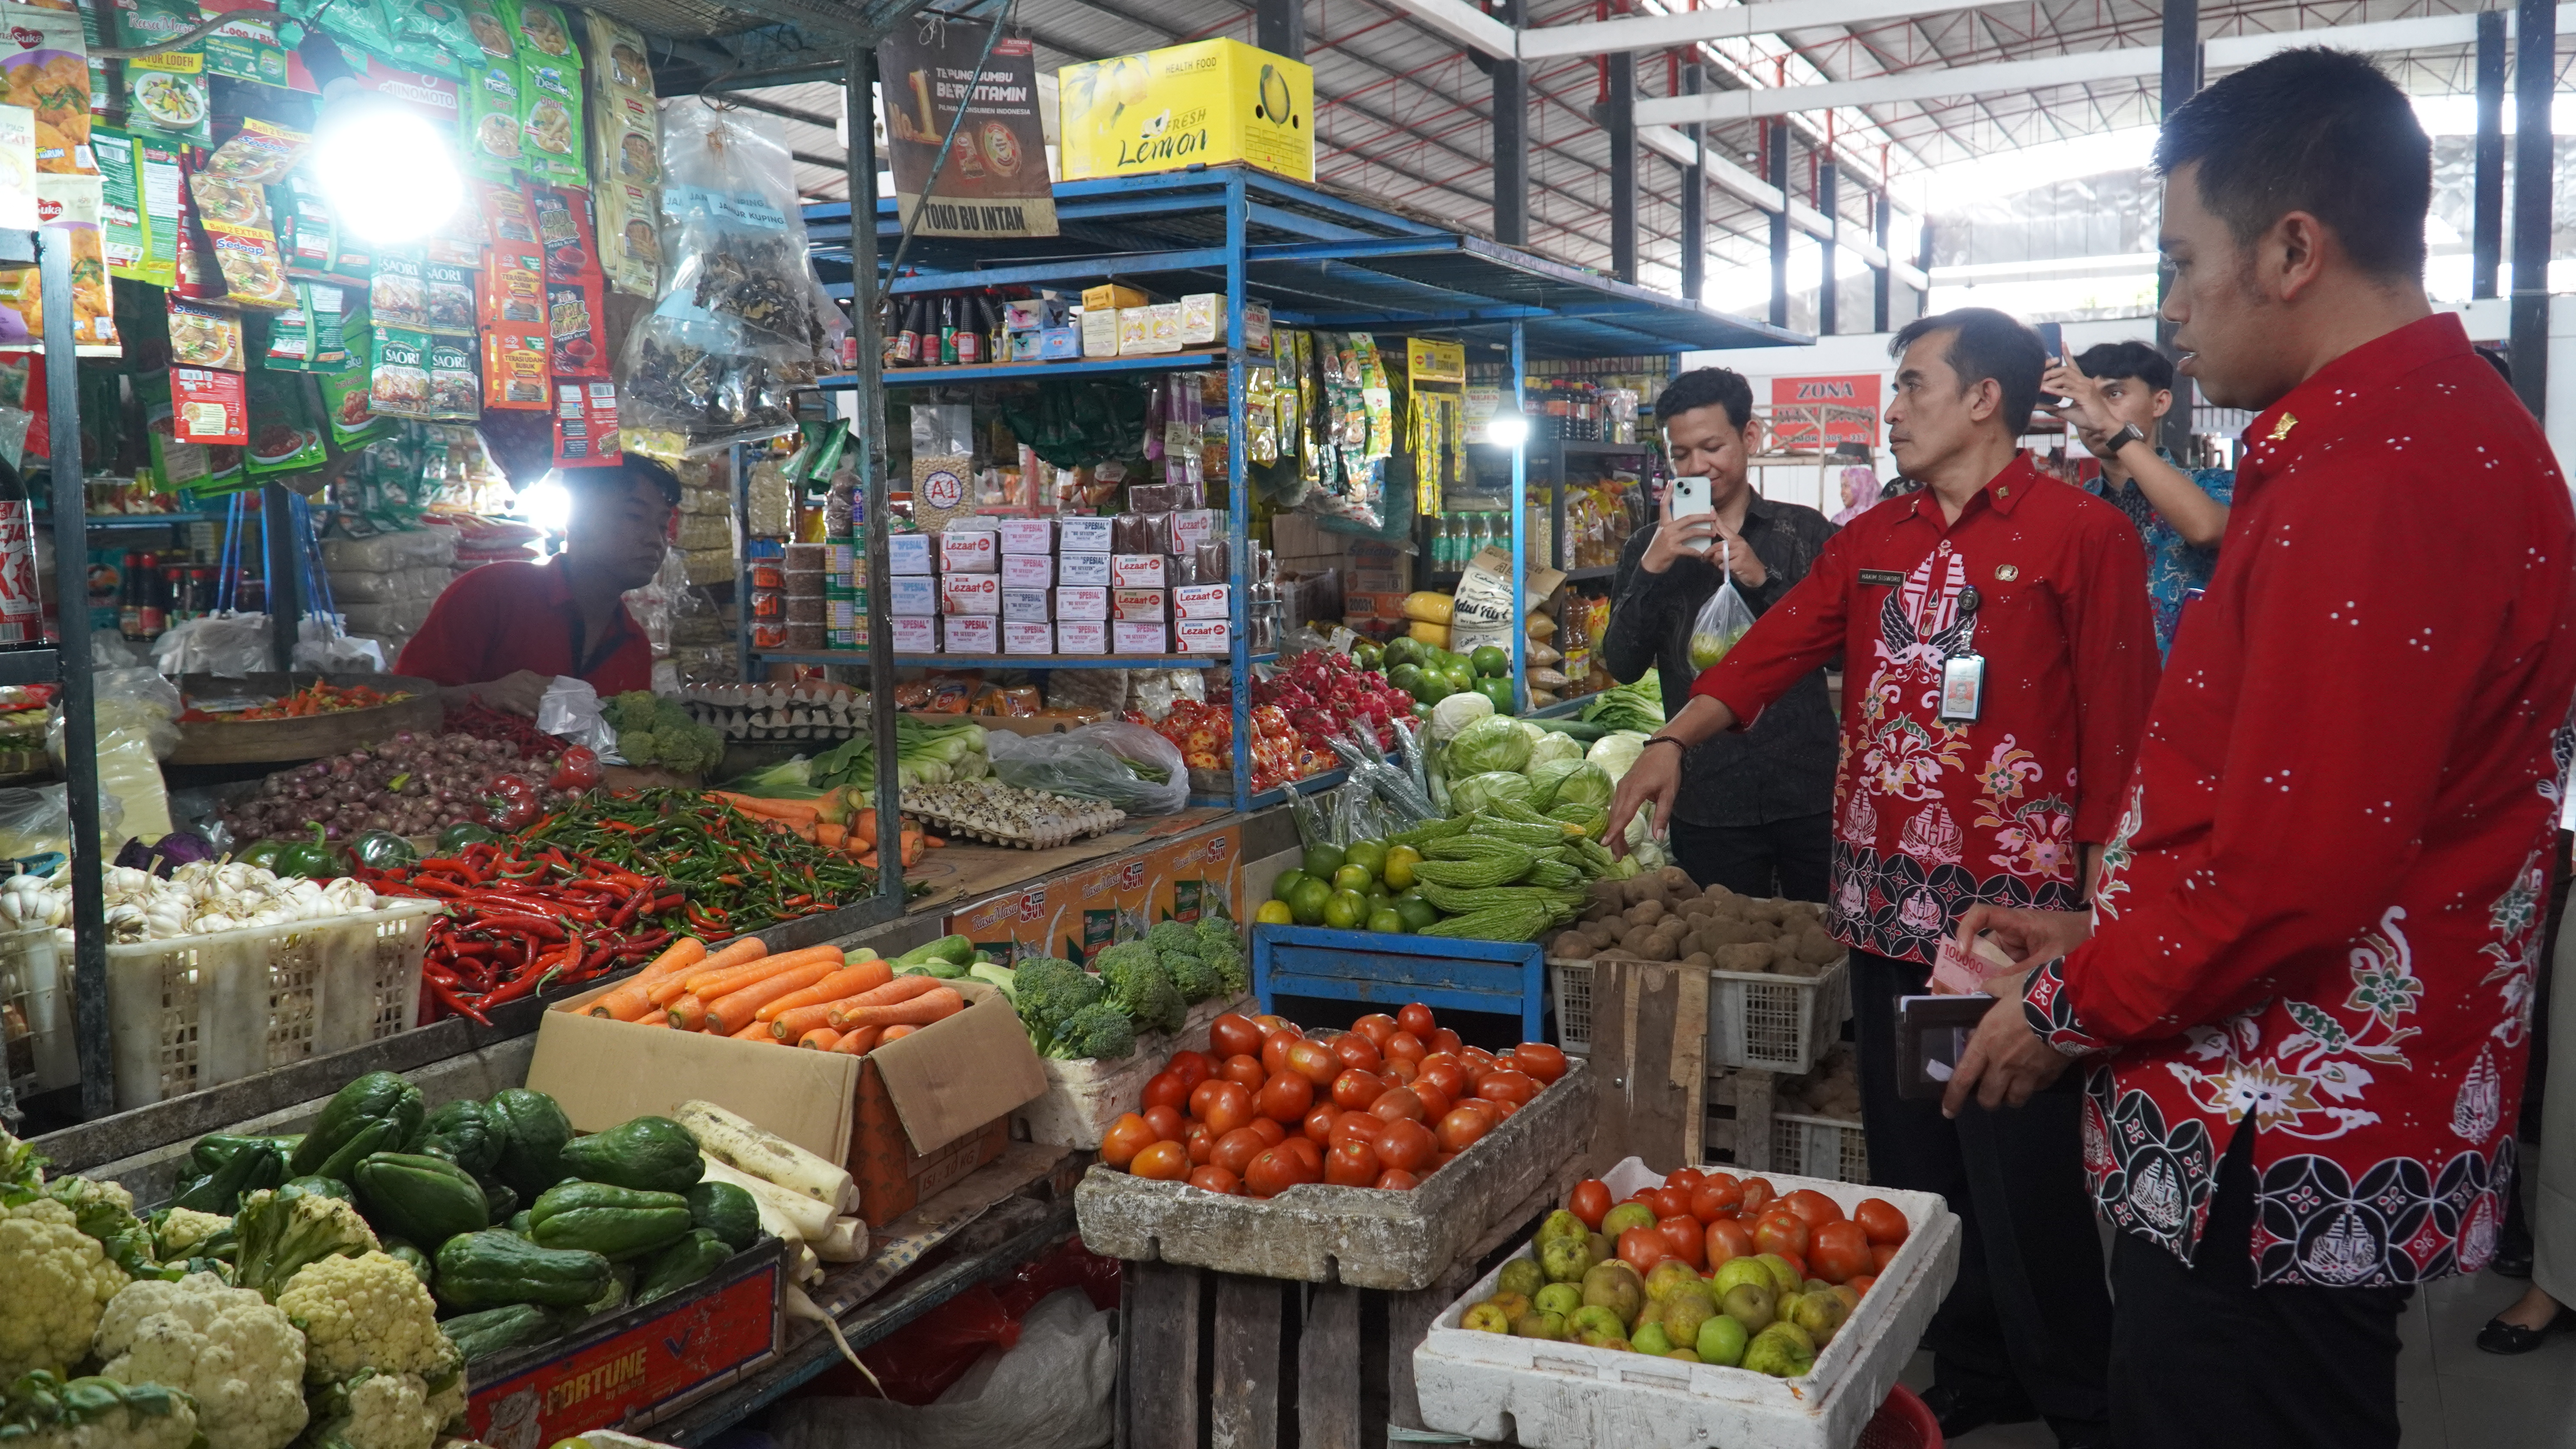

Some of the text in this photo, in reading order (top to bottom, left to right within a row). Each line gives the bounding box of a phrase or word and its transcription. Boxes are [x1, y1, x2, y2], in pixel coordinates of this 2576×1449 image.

[14, 32, 43, 42] Suka
[219, 25, 249, 39] 1.000
[167, 55, 193, 67] LODEH
[1166, 61, 1193, 74] HEALTH
[1196, 57, 1217, 70] FOOD
[936, 67, 973, 81] TEPUNG
[484, 79, 517, 99] Desaku
[535, 75, 568, 97] Desaku
[936, 82, 1027, 102] BERITAMIN
[492, 96, 512, 110] kari
[540, 95, 563, 110] opor
[252, 122, 268, 133] Beli
[1166, 108, 1206, 133] FRESH
[237, 135, 292, 153] Sedaap
[1118, 129, 1208, 167] Lemon
[39, 149, 64, 158] HARUM
[748, 212, 784, 224] KUPING
[924, 203, 1026, 231] TOKO BU INTAN
[209, 223, 226, 233] Beli
[234, 227, 263, 239] EXTRA
[216, 239, 264, 255] Sedaap
[382, 259, 419, 276] SAORI
[386, 349, 420, 365] SAORI
[432, 355, 468, 368] SAORI
[1797, 381, 1855, 400] ZONA
[931, 480, 957, 499] A1
[1178, 520, 1200, 530] Lezaat
[946, 540, 977, 550] Lezaat
[1119, 561, 1148, 570] Lezaat
[949, 582, 981, 593] Lezaat
[1118, 596, 1148, 604] Lezaat
[1180, 592, 1211, 601] Lezaat
[1182, 626, 1213, 635] Lezaat
[1033, 893, 1044, 902] kara
[1945, 943, 1984, 974] 100000
[922, 1173, 936, 1193] ISI
[945, 1160, 958, 1179] 10
[960, 1149, 975, 1170] KG
[547, 1346, 647, 1416] FORTUNE
[605, 1389, 615, 1400] by
